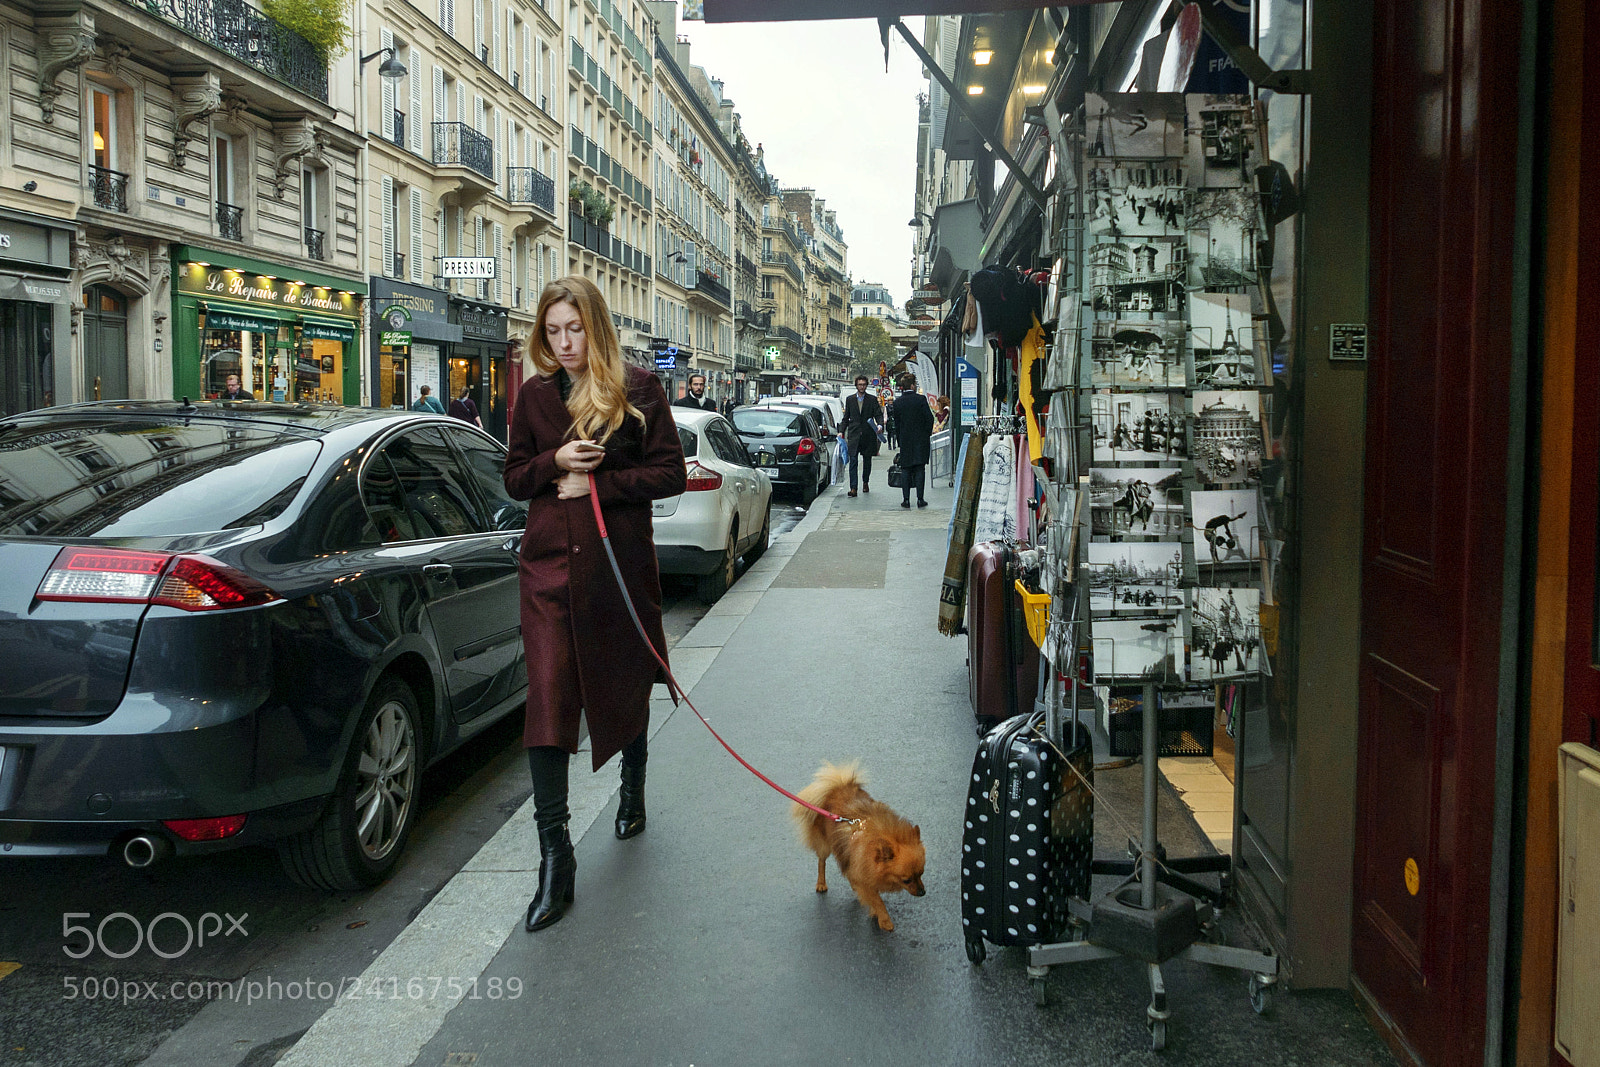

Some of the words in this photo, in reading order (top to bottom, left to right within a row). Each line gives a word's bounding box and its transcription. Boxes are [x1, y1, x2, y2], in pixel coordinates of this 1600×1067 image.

[0, 233, 11, 248] S
[444, 261, 493, 275] PRESSING
[206, 272, 224, 292] Le
[228, 277, 278, 302] Repaire
[283, 287, 297, 304] de
[300, 290, 343, 311] Bacchus
[391, 291, 434, 313] PRESSING
[919, 334, 938, 344] G20
[957, 363, 968, 378] P
